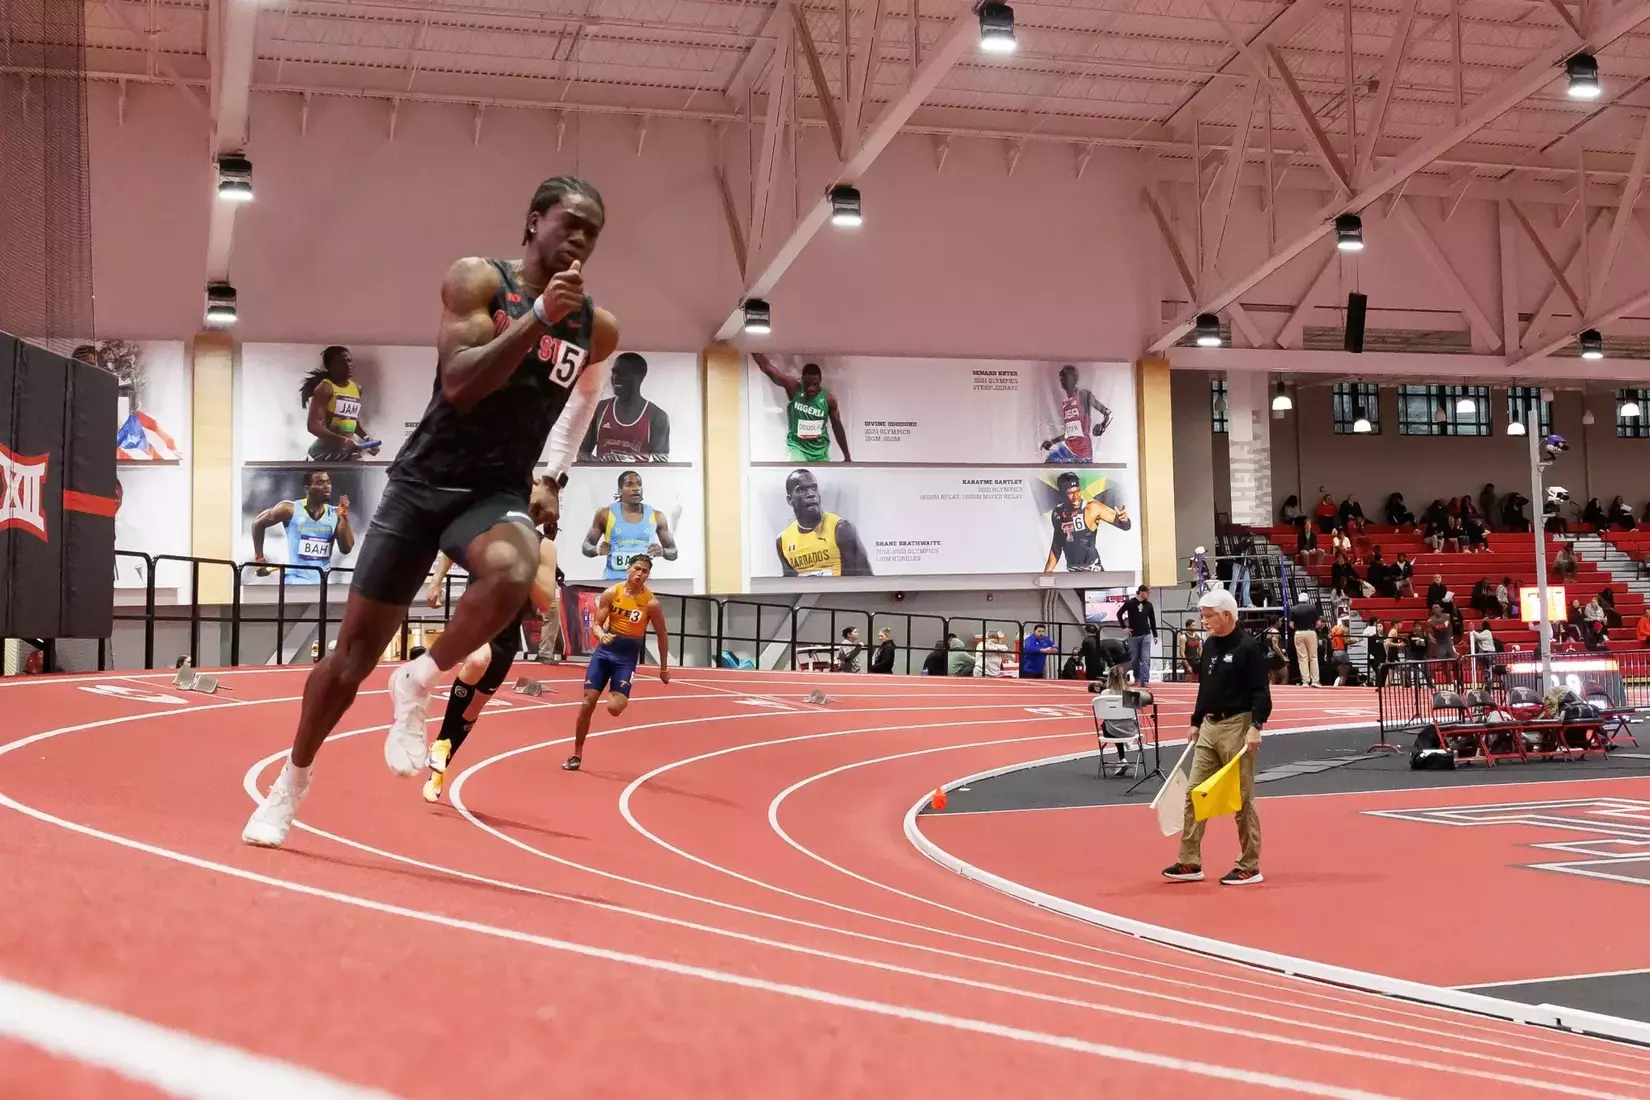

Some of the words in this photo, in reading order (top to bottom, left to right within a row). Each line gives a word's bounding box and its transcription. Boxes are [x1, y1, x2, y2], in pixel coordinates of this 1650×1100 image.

[555, 345, 580, 383] 5
[340, 403, 358, 414] JAM
[794, 402, 825, 417] NIGERIA
[304, 542, 329, 555] BAH
[790, 549, 830, 568] BARBADOS
[630, 610, 641, 623] 3
